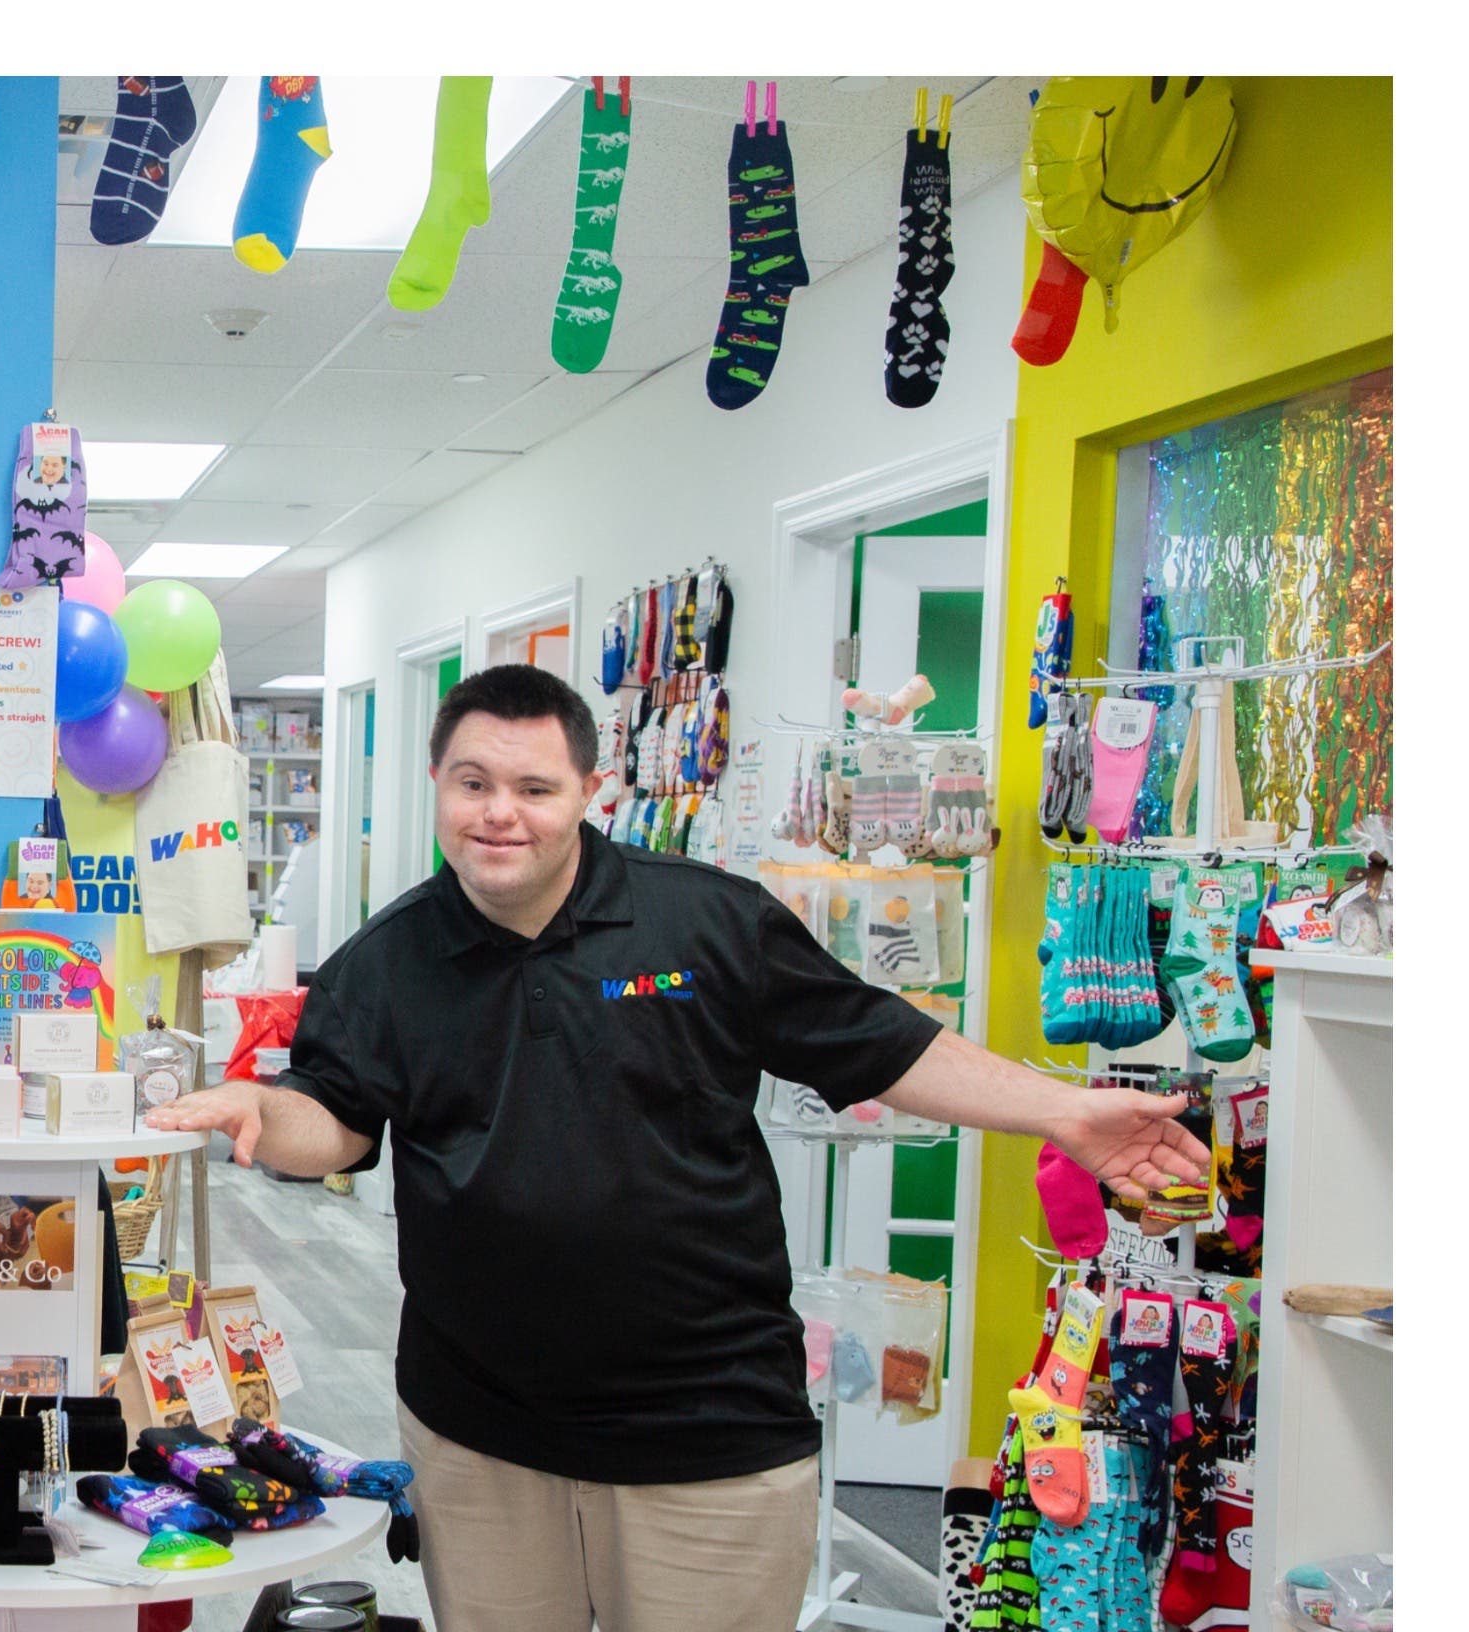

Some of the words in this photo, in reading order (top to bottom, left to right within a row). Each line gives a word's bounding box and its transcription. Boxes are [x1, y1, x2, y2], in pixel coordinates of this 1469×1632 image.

[7, 713, 46, 723] straight
[601, 970, 693, 1000] WAHOOO
[19, 994, 63, 1009] LINES
[25, 1259, 63, 1282] Co
